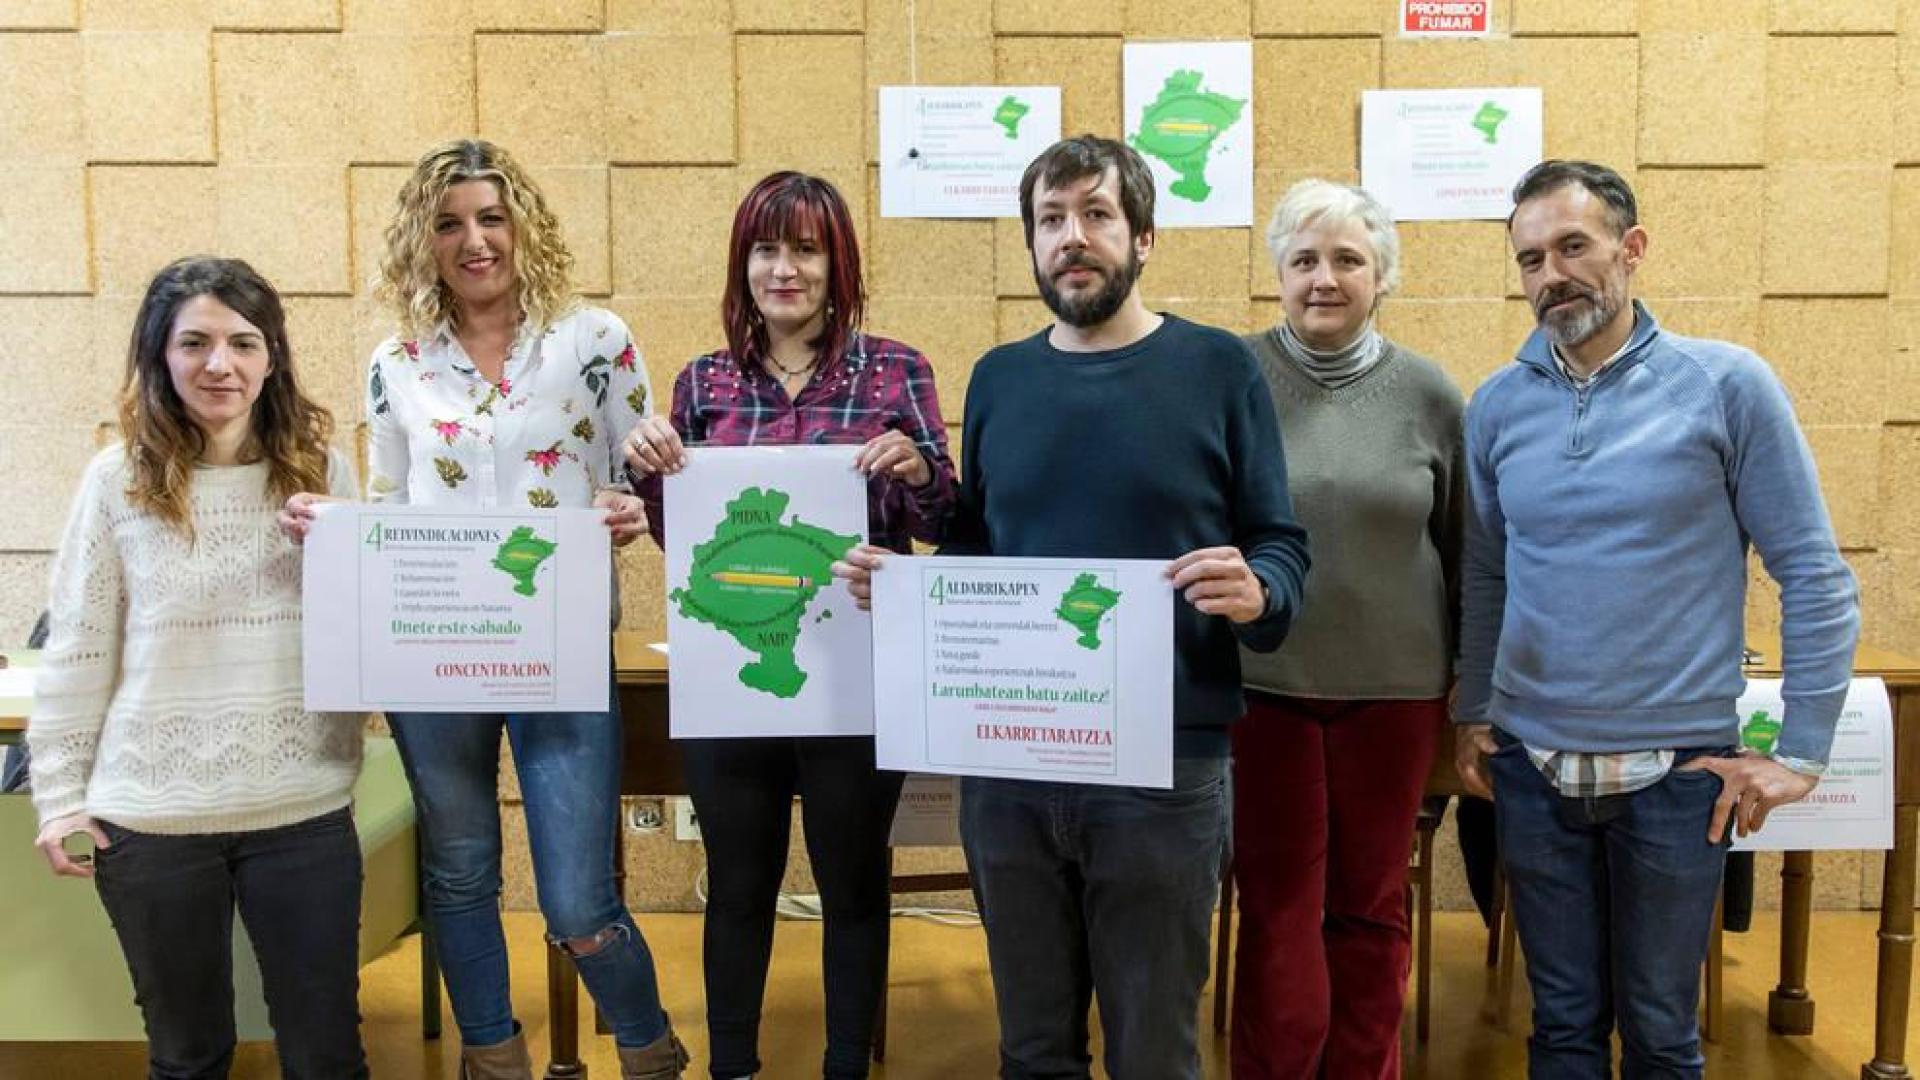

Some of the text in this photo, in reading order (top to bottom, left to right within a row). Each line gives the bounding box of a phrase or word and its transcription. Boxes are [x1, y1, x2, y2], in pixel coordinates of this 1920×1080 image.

[1408, 3, 1483, 16] PROHIBIDO
[1419, 16, 1473, 30] FUMAR
[729, 510, 772, 526] PIDNA
[365, 521, 501, 552] 4 REIVINDICACIONES
[929, 575, 1040, 606] 4 ALDARRIKAPEN
[438, 621, 467, 635] este
[758, 632, 789, 648] NAIP
[932, 682, 1023, 700] Larunbatean
[1026, 684, 1058, 701] batu
[976, 723, 1113, 746] ELKARRETARATZEA
